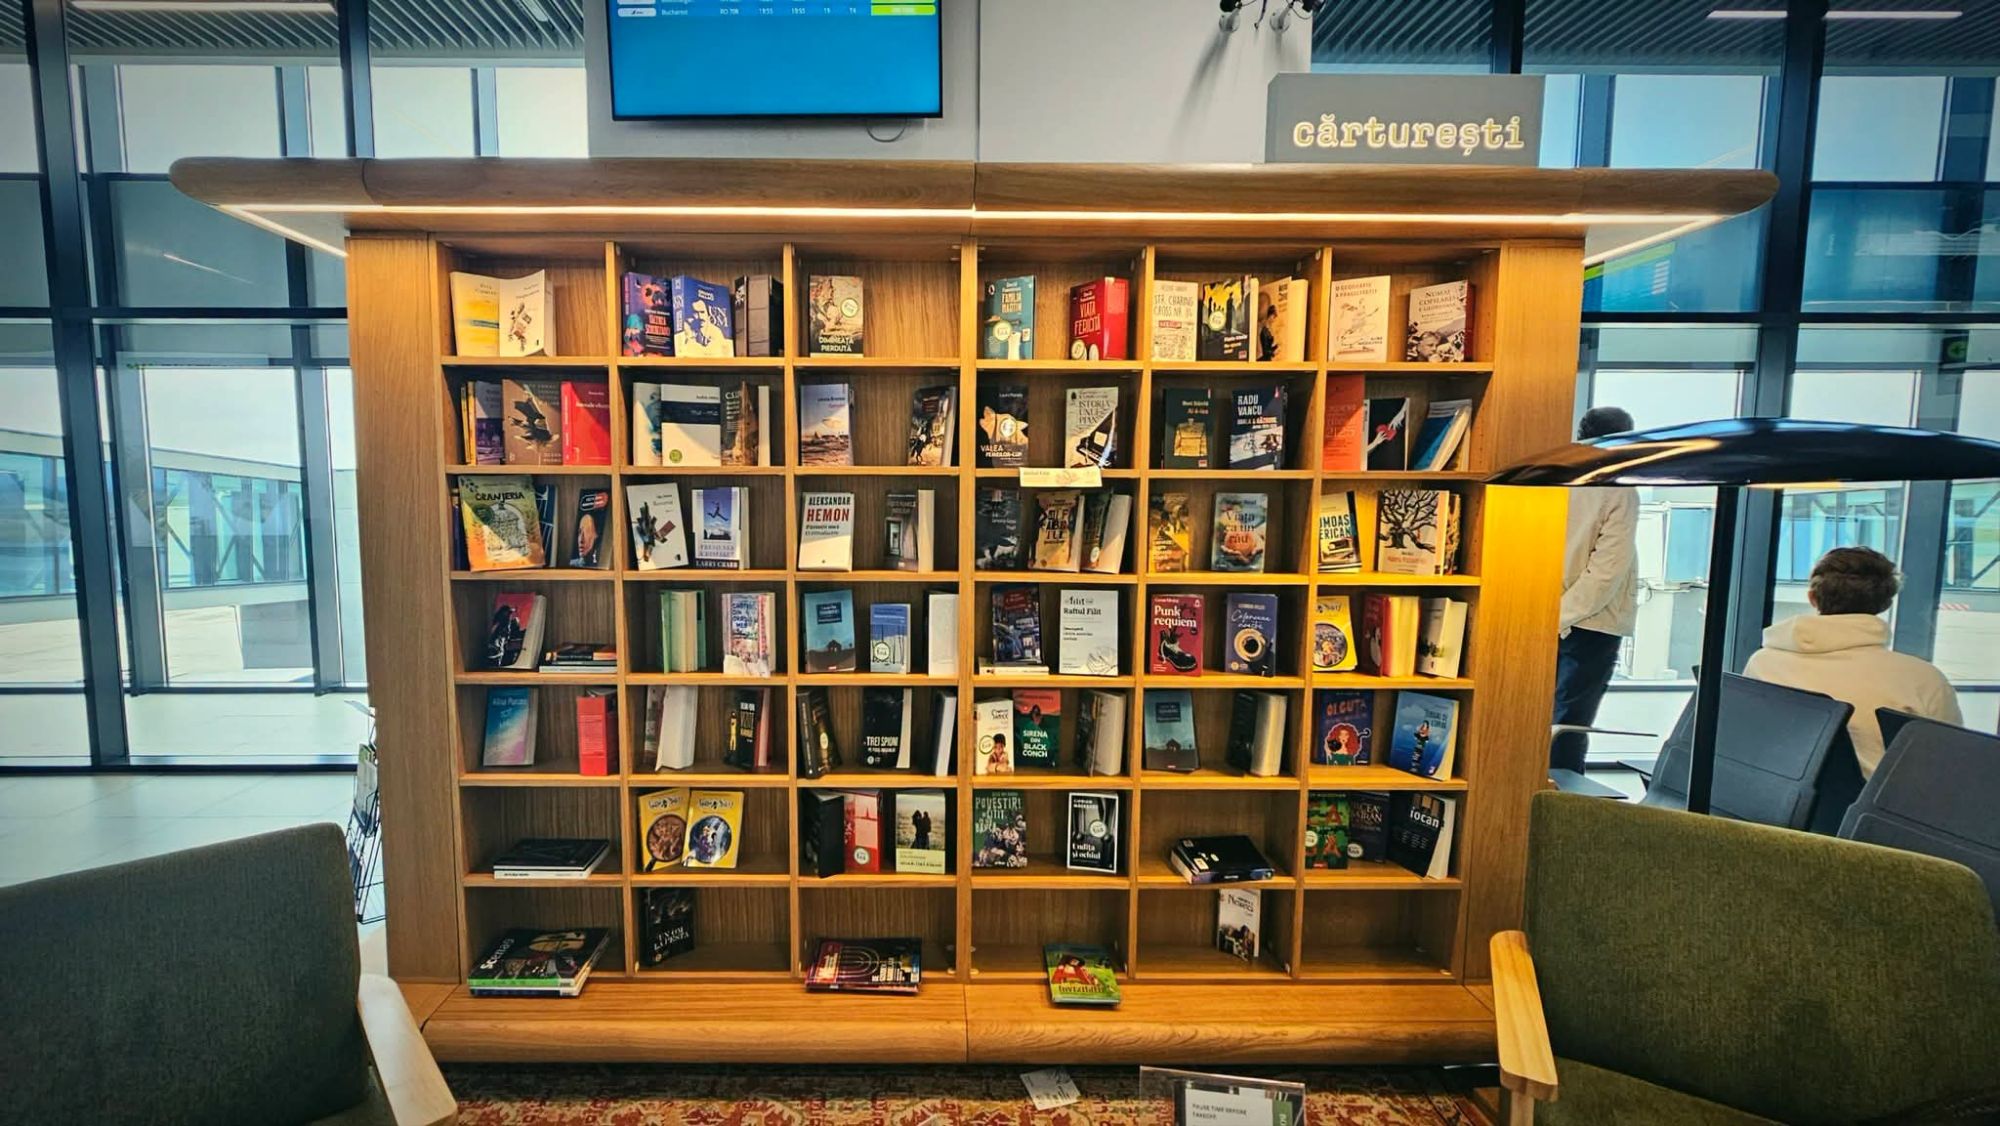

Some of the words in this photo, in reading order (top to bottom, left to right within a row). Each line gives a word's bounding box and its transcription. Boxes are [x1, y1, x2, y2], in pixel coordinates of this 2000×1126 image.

[1293, 113, 1524, 156] cărturești
[1237, 395, 1259, 405] RADU
[1237, 406, 1263, 416] VANCU
[808, 496, 851, 506] ALEKSANDAR
[806, 508, 850, 522] HEMON
[1063, 607, 1085, 615] Raftul
[1154, 605, 1181, 617] Punk
[1154, 616, 1197, 629] requiem
[1023, 730, 1048, 738] SIRENA
[866, 736, 880, 747] TREI
[1023, 743, 1047, 751] BLACK
[1022, 750, 1048, 758] CONCH
[1410, 807, 1440, 829] iocan
